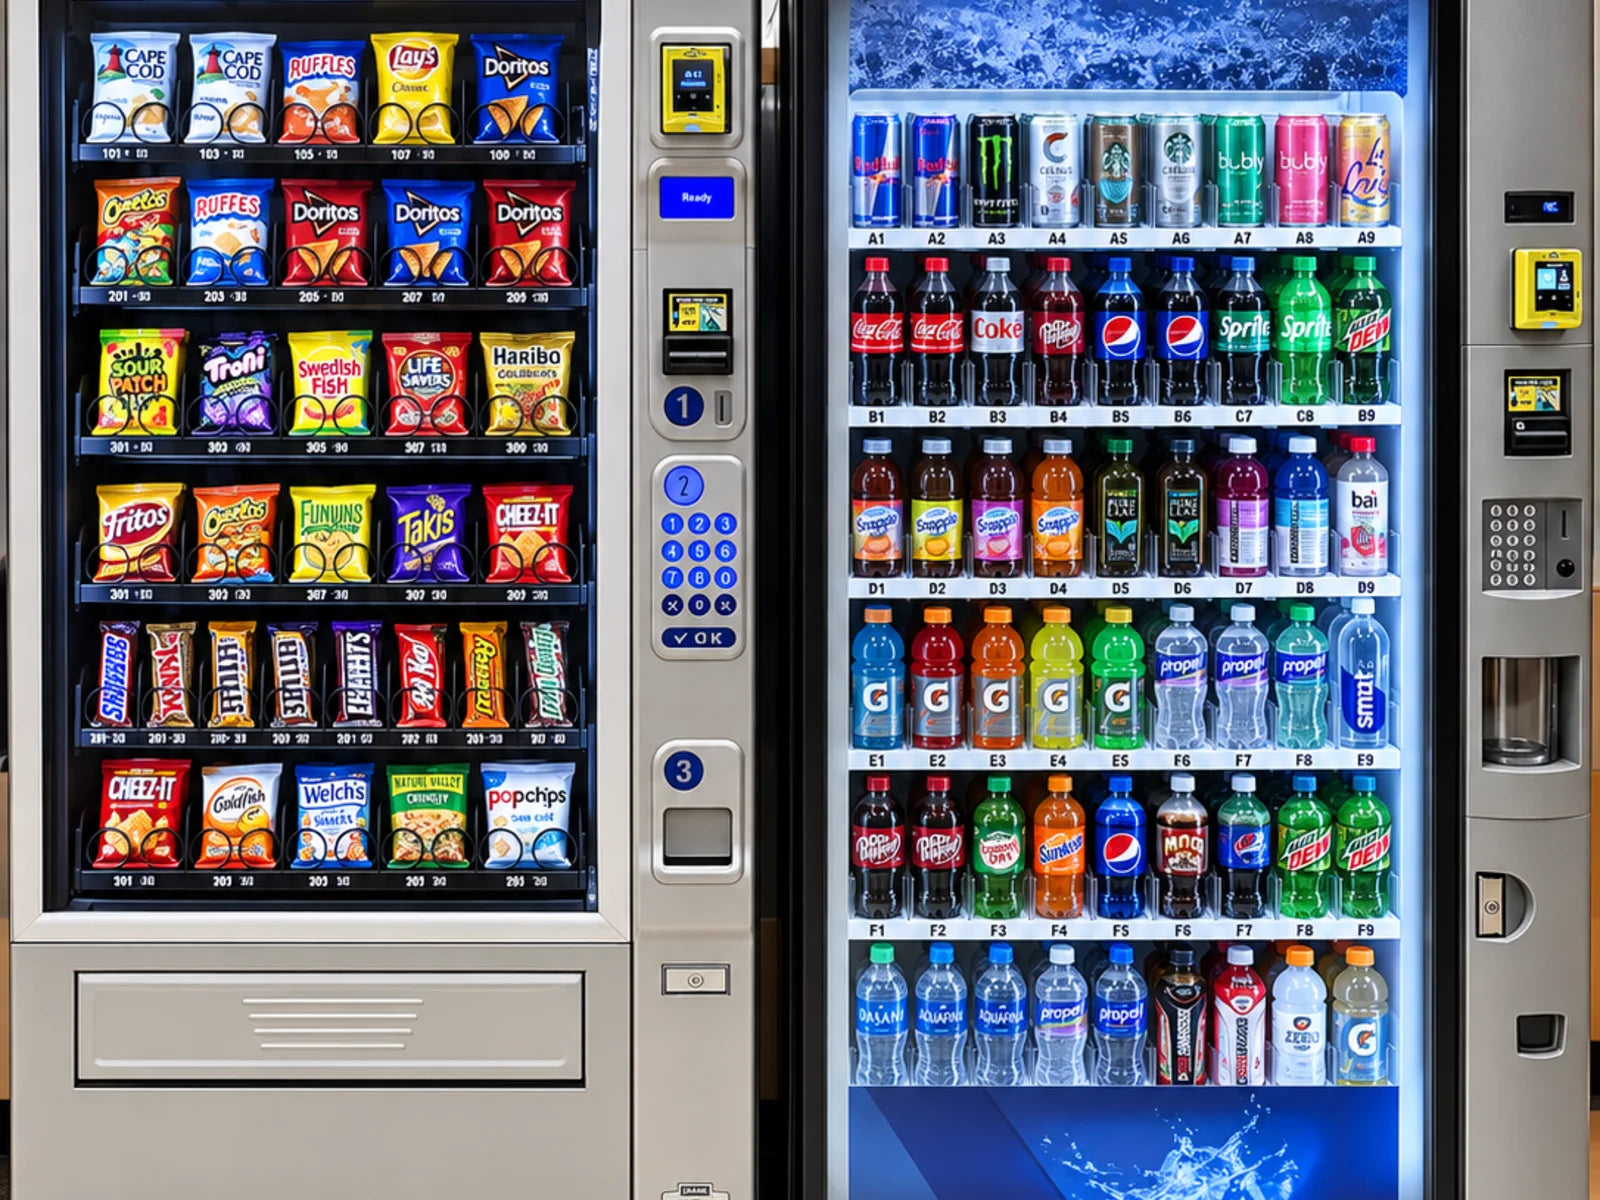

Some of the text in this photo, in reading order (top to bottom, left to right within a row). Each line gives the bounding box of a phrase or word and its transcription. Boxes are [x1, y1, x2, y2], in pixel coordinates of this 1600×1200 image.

[124, 49, 167, 64] CAPE
[223, 50, 263, 66] CAPE
[126, 64, 165, 79] COD
[224, 65, 262, 80] COD
[290, 55, 356, 79] RUFFLES
[484, 58, 550, 77] Doritos
[391, 149, 412, 161] 107
[682, 193, 712, 204] Ready
[294, 204, 359, 222] Doritos
[395, 204, 461, 222] Doritos
[497, 204, 563, 222] Doritos
[867, 233, 885, 245] A1
[927, 232, 946, 246] A2
[987, 232, 1006, 245] A3
[1048, 233, 1067, 245] A4
[1171, 232, 1191, 245] A6
[1233, 232, 1252, 245] A7
[1295, 232, 1314, 245] A8
[1357, 231, 1376, 245] A9
[108, 290, 128, 303] 201
[402, 291, 423, 303] 207
[973, 317, 1022, 339] Coke
[493, 347, 561, 366] Haribo
[111, 359, 163, 377] SOUR
[407, 357, 442, 374] LIFE
[111, 374, 166, 395] PATCH
[312, 376, 348, 395] FISH
[676, 393, 689, 419] 1
[868, 411, 885, 424] B1
[928, 411, 946, 424] B2
[989, 411, 1007, 424] B3
[1049, 411, 1068, 424] B4
[1174, 410, 1192, 423] B6
[1235, 410, 1253, 423] C7
[1296, 410, 1315, 423] C8
[1358, 409, 1376, 422] B9
[678, 475, 689, 497] 2
[1352, 490, 1378, 508] bai
[102, 505, 168, 541] Fritos
[669, 517, 730, 531] 1 2 3
[397, 508, 455, 553] Takis
[668, 571, 677, 584] 7
[695, 571, 704, 585] 8
[868, 583, 885, 595] D1
[929, 583, 946, 595] D2
[989, 583, 1007, 595] D3
[1049, 583, 1068, 595] D4
[1173, 583, 1192, 595] D6
[1235, 582, 1253, 595] D7
[1296, 582, 1315, 595] D8
[1357, 581, 1376, 595] D9
[862, 681, 888, 713] G
[923, 681, 949, 713] G
[983, 681, 1009, 713] G
[1043, 681, 1069, 713] G
[1105, 681, 1131, 713] G
[869, 754, 885, 768] E1
[929, 755, 946, 768] E2
[989, 755, 1007, 768] E3
[1049, 755, 1067, 768] E4
[1235, 754, 1252, 767] F7
[1295, 754, 1313, 767] F8
[1357, 754, 1374, 767] E9
[676, 760, 692, 783] 3
[303, 781, 365, 804] Welch's
[488, 786, 567, 811] popchips
[869, 924, 885, 937] F1
[930, 924, 947, 937] F2
[990, 925, 1007, 937] F3
[1051, 925, 1068, 937] F4
[1236, 924, 1253, 937] F7
[1296, 924, 1314, 937] F8
[1357, 924, 1375, 937] F9
[1348, 1024, 1376, 1056] G
